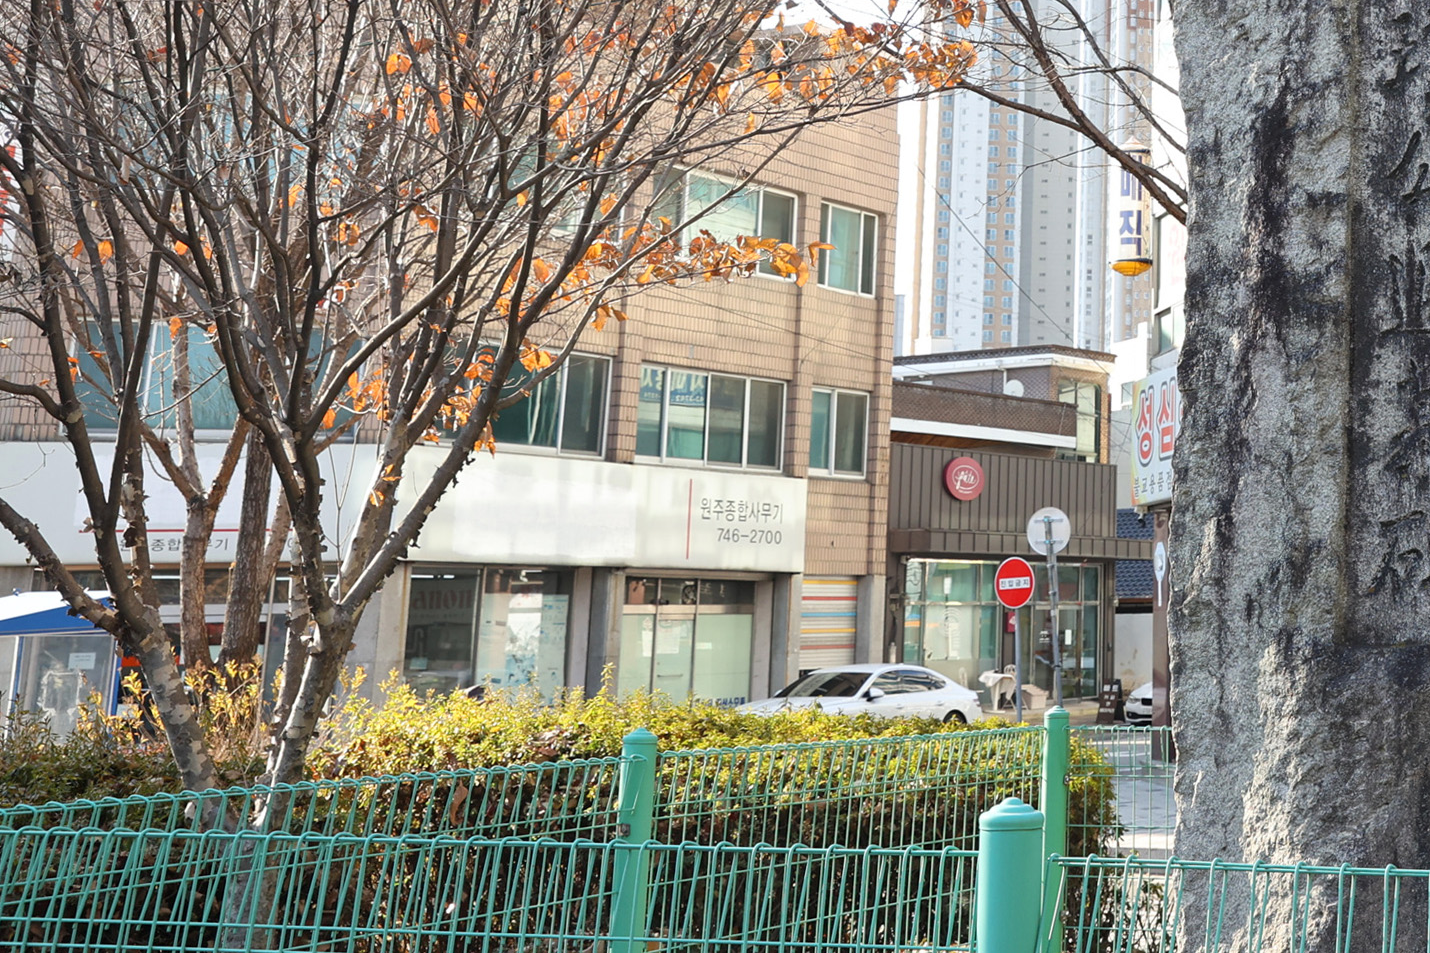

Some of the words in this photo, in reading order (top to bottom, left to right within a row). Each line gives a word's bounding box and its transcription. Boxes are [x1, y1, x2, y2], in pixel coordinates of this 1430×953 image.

[1136, 379, 1183, 465] 성심
[700, 497, 784, 524] 원주종합사무기
[717, 527, 783, 545] 746-2700
